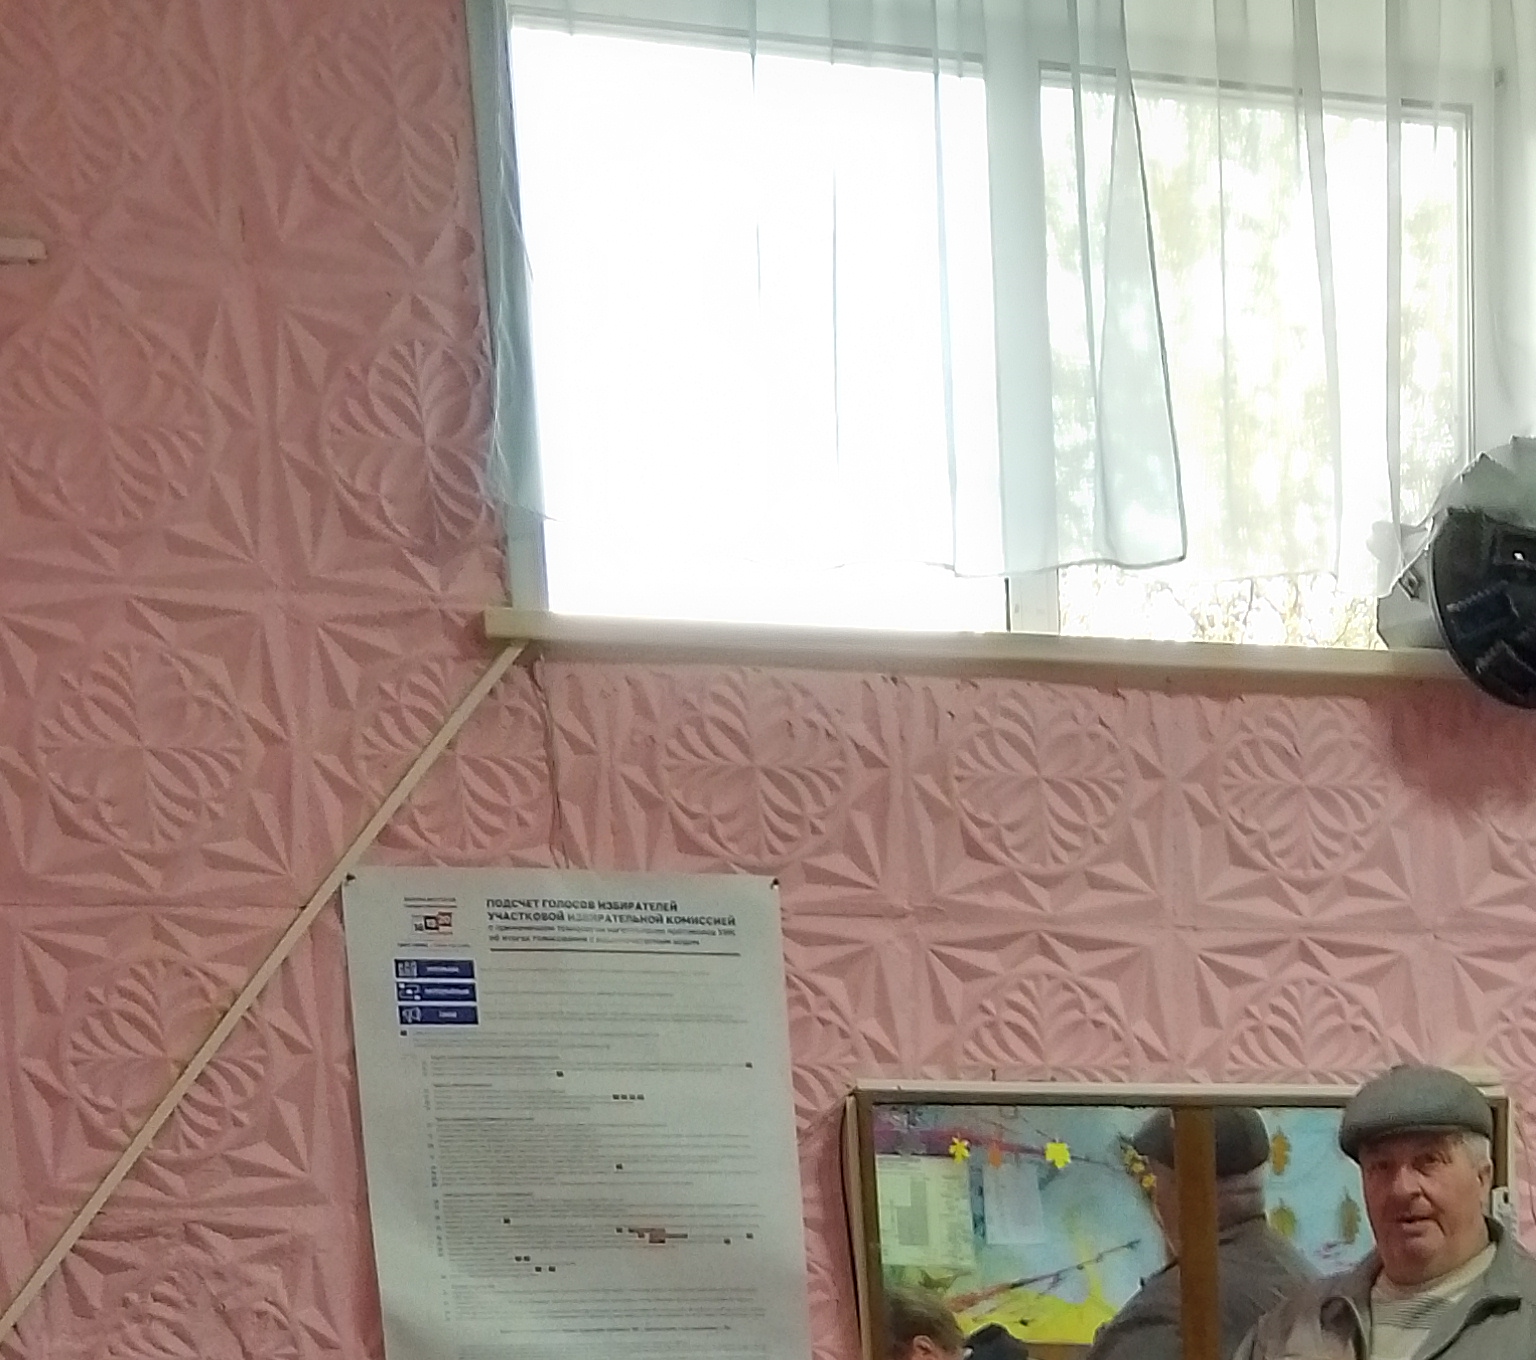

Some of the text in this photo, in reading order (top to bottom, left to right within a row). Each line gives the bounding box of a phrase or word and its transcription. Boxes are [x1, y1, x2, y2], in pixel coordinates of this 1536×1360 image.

[486, 898, 678, 912] ПОДСЧЕТ ГОЛОСОВ ИЗБИРАТЕЛЕЙ
[486, 909, 566, 921] УЧАСТКОВОЙ
[665, 914, 737, 926] КОМИССИЕЙ
